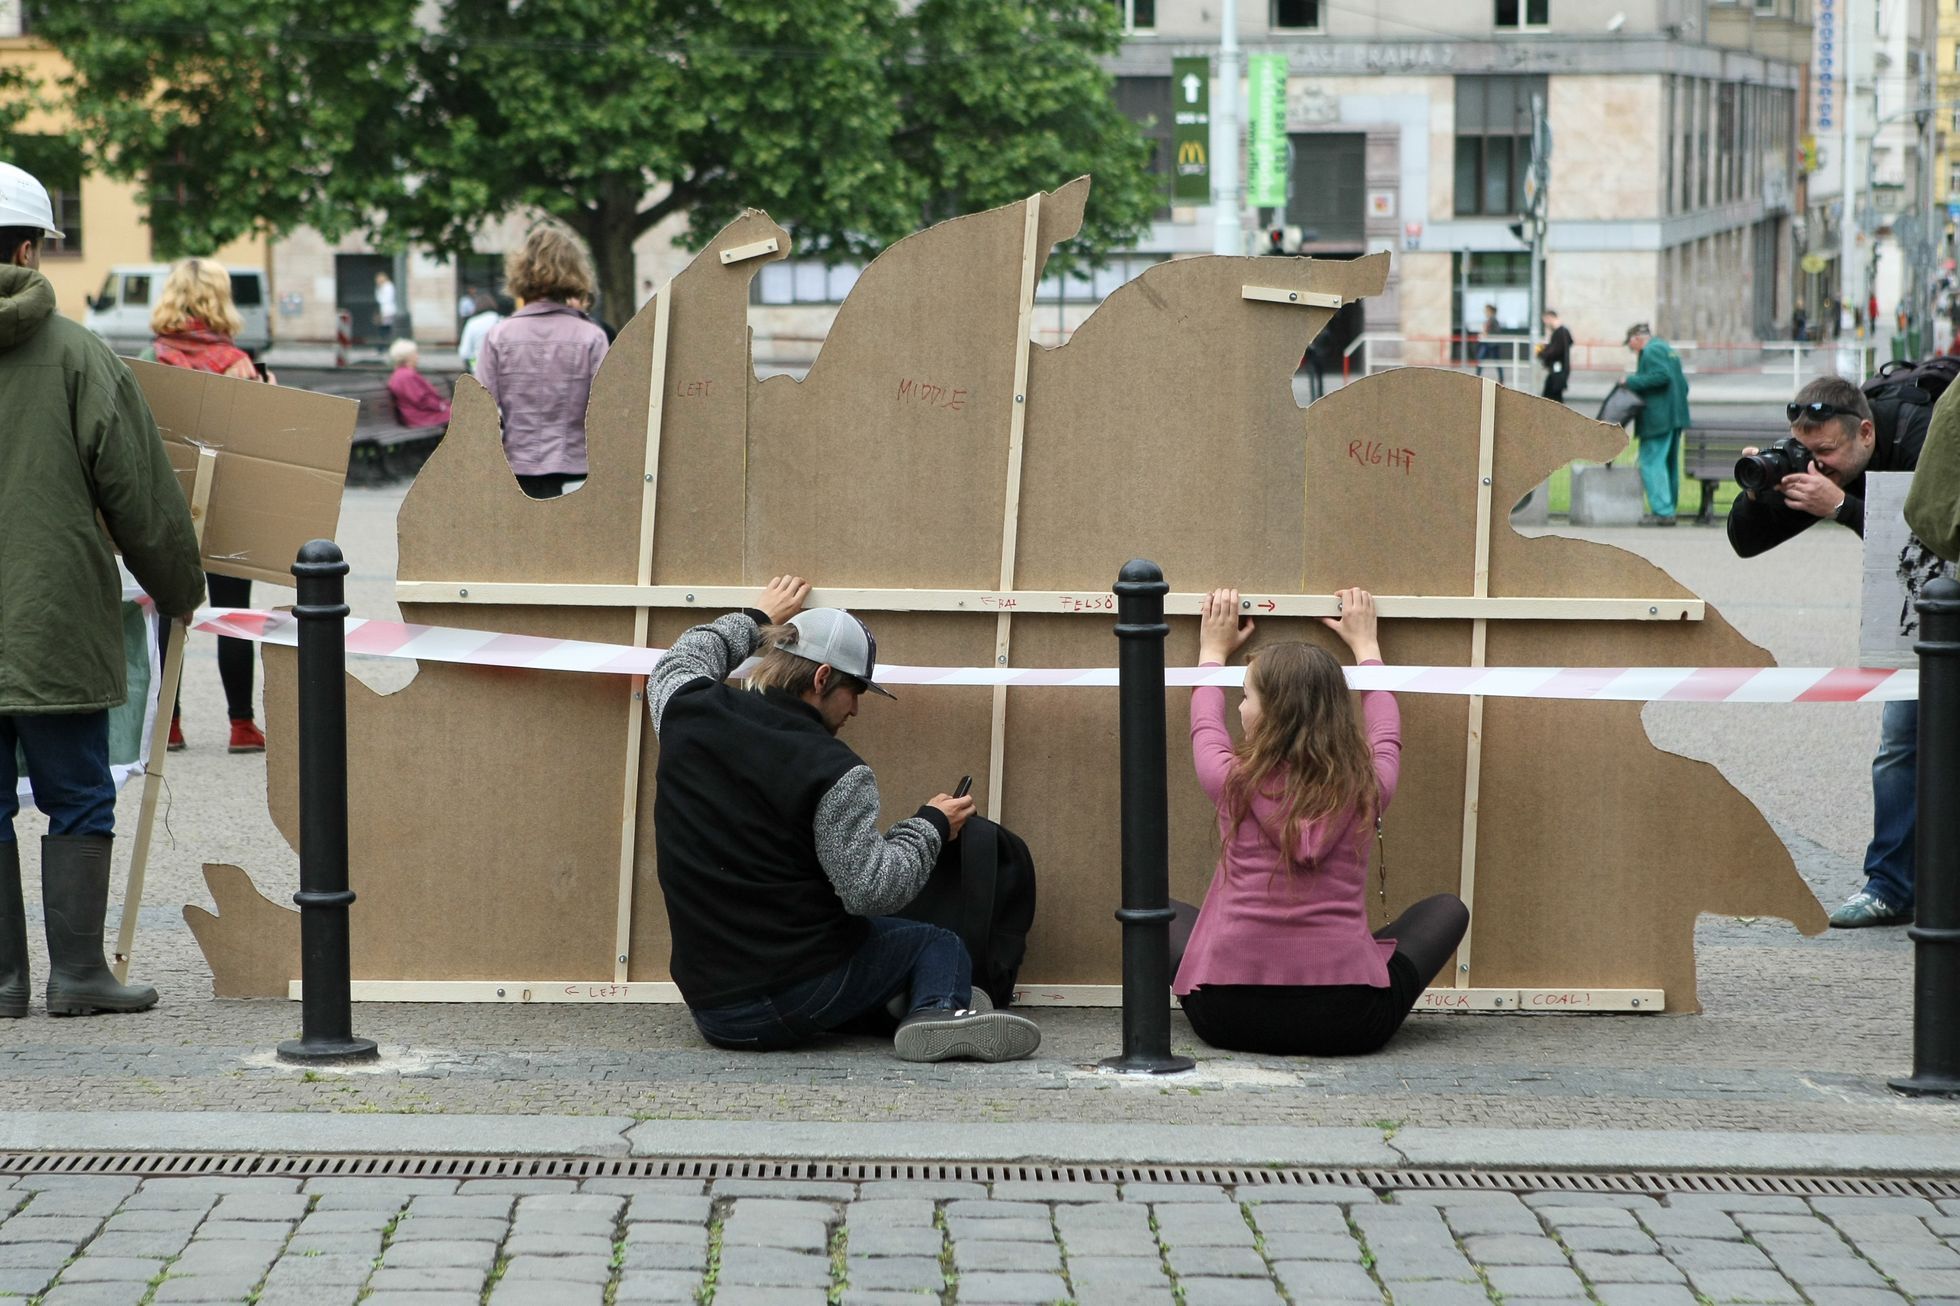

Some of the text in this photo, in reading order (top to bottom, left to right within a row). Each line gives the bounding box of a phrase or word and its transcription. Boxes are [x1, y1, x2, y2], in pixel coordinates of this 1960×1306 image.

[677, 380, 713, 398] LEFT
[897, 378, 967, 411] MIDDLE
[1349, 440, 1416, 475] RIGHT
[589, 984, 630, 998] LEFT
[1425, 992, 1591, 1009] FUCK COAL!
